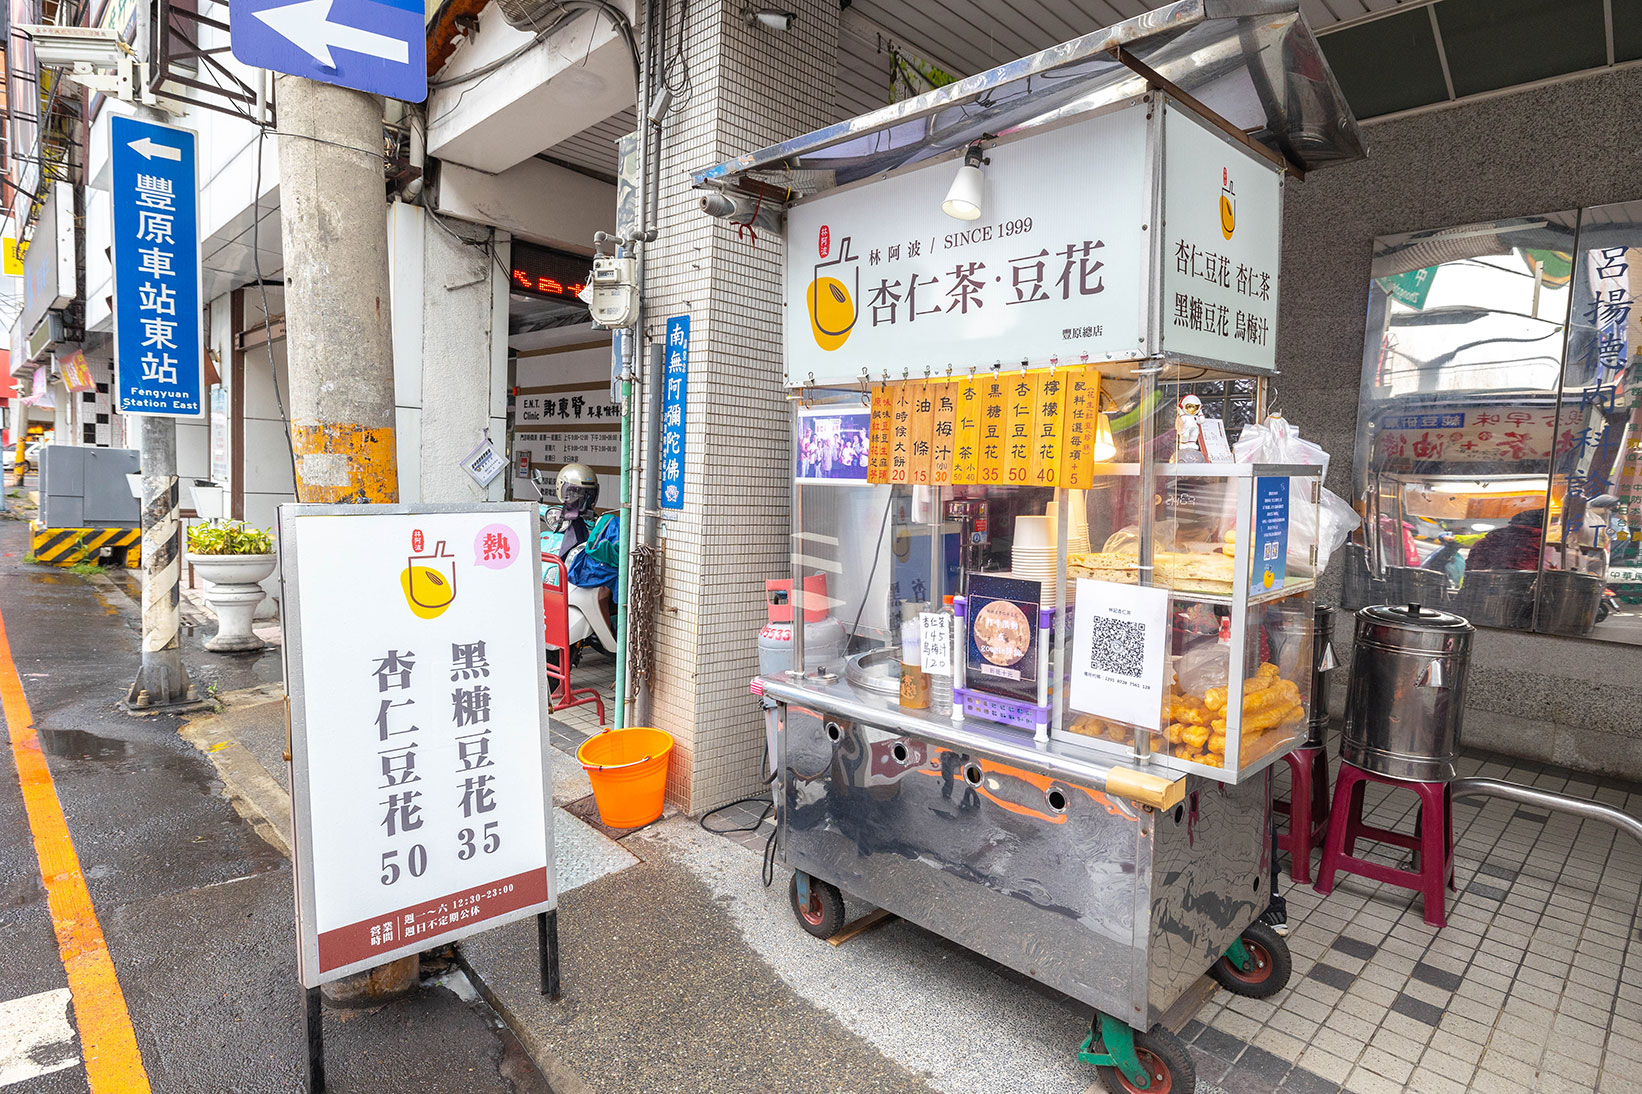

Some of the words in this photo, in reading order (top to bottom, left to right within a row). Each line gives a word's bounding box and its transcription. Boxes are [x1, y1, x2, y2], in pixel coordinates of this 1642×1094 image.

[944, 226, 992, 250] SINCE
[998, 217, 1033, 239] 1999
[134, 173, 178, 385] 豐原車站東站
[1175, 239, 1231, 288] 杏仁豆花
[1235, 263, 1270, 301] 杏仁茶
[1062, 325, 1103, 340] 豐原總店
[1174, 292, 1229, 337] 黑糖豆花
[1234, 310, 1269, 346] 烏梅汁
[123, 397, 167, 409] Station
[173, 400, 198, 410] East
[131, 387, 189, 399] Fengyuan
[523, 399, 540, 408] E.N.T.
[665, 323, 685, 482] 南無阿彌陀佛
[523, 411, 540, 420] Clinic
[543, 395, 585, 419] 謝東賢
[1011, 382, 1030, 459] 杏仁豆花
[1040, 380, 1060, 459] 檸檬豆花
[913, 398, 931, 456] 油條
[935, 396, 953, 461] 烏梅汁
[958, 386, 977, 460] 杏仁茶
[984, 384, 1002, 460] 黑糖豆花
[892, 469, 905, 481] 20
[914, 470, 927, 482] 15
[935, 471, 947, 482] 30
[966, 473, 975, 481] 40
[982, 467, 999, 481] 35
[1008, 467, 1027, 481] 50
[1037, 468, 1055, 482] 40
[483, 532, 511, 561] 熱
[924, 630, 946, 642] 145
[925, 658, 946, 669] 120
[450, 640, 497, 818] 黑糖豆花
[371, 650, 424, 837] 杏仁豆花
[457, 820, 501, 861] 35
[380, 843, 428, 886] 50
[452, 883, 514, 910] 12:30-23:00
[370, 921, 393, 936] 營業
[404, 905, 480, 938] 週日不定期公休
[370, 933, 394, 946] 時間
